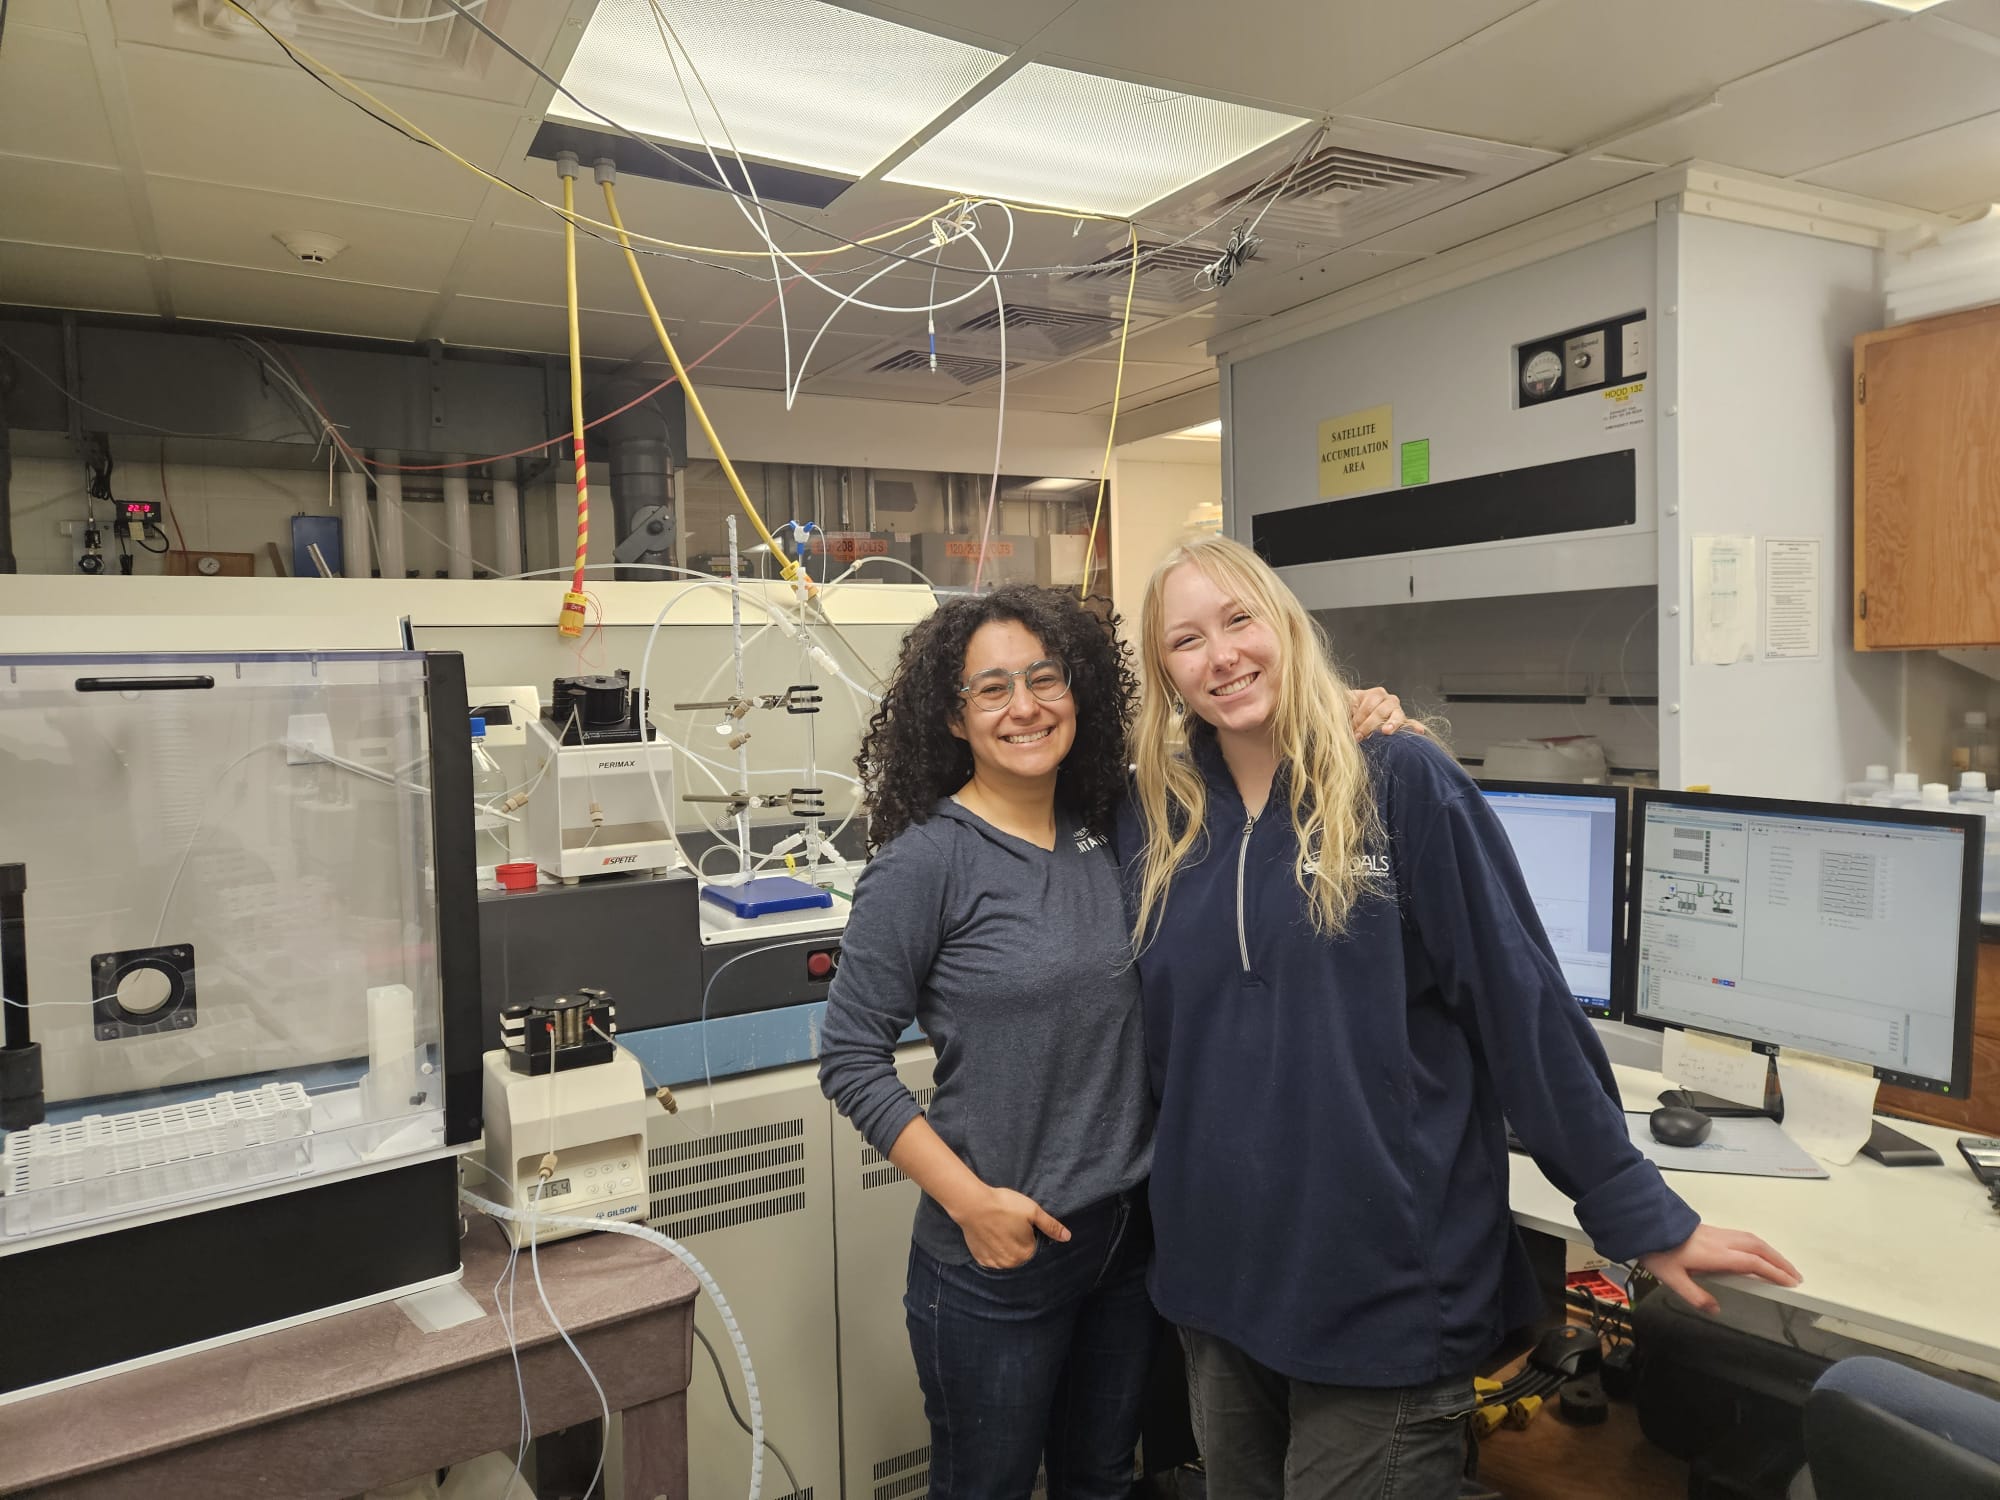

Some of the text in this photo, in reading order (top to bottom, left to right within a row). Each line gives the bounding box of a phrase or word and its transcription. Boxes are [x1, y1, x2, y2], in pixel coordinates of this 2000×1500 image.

[1604, 387, 1628, 399] HOOD
[1630, 383, 1644, 393] 132
[1331, 423, 1377, 442] SATELLITE
[1321, 440, 1390, 463] ACCUMULATION
[1342, 461, 1366, 474] AREA
[598, 760, 636, 769] PERIMAX
[609, 854, 639, 865] SPETEC
[1349, 855, 1390, 871] OALS
[607, 1204, 638, 1218] GILSON
